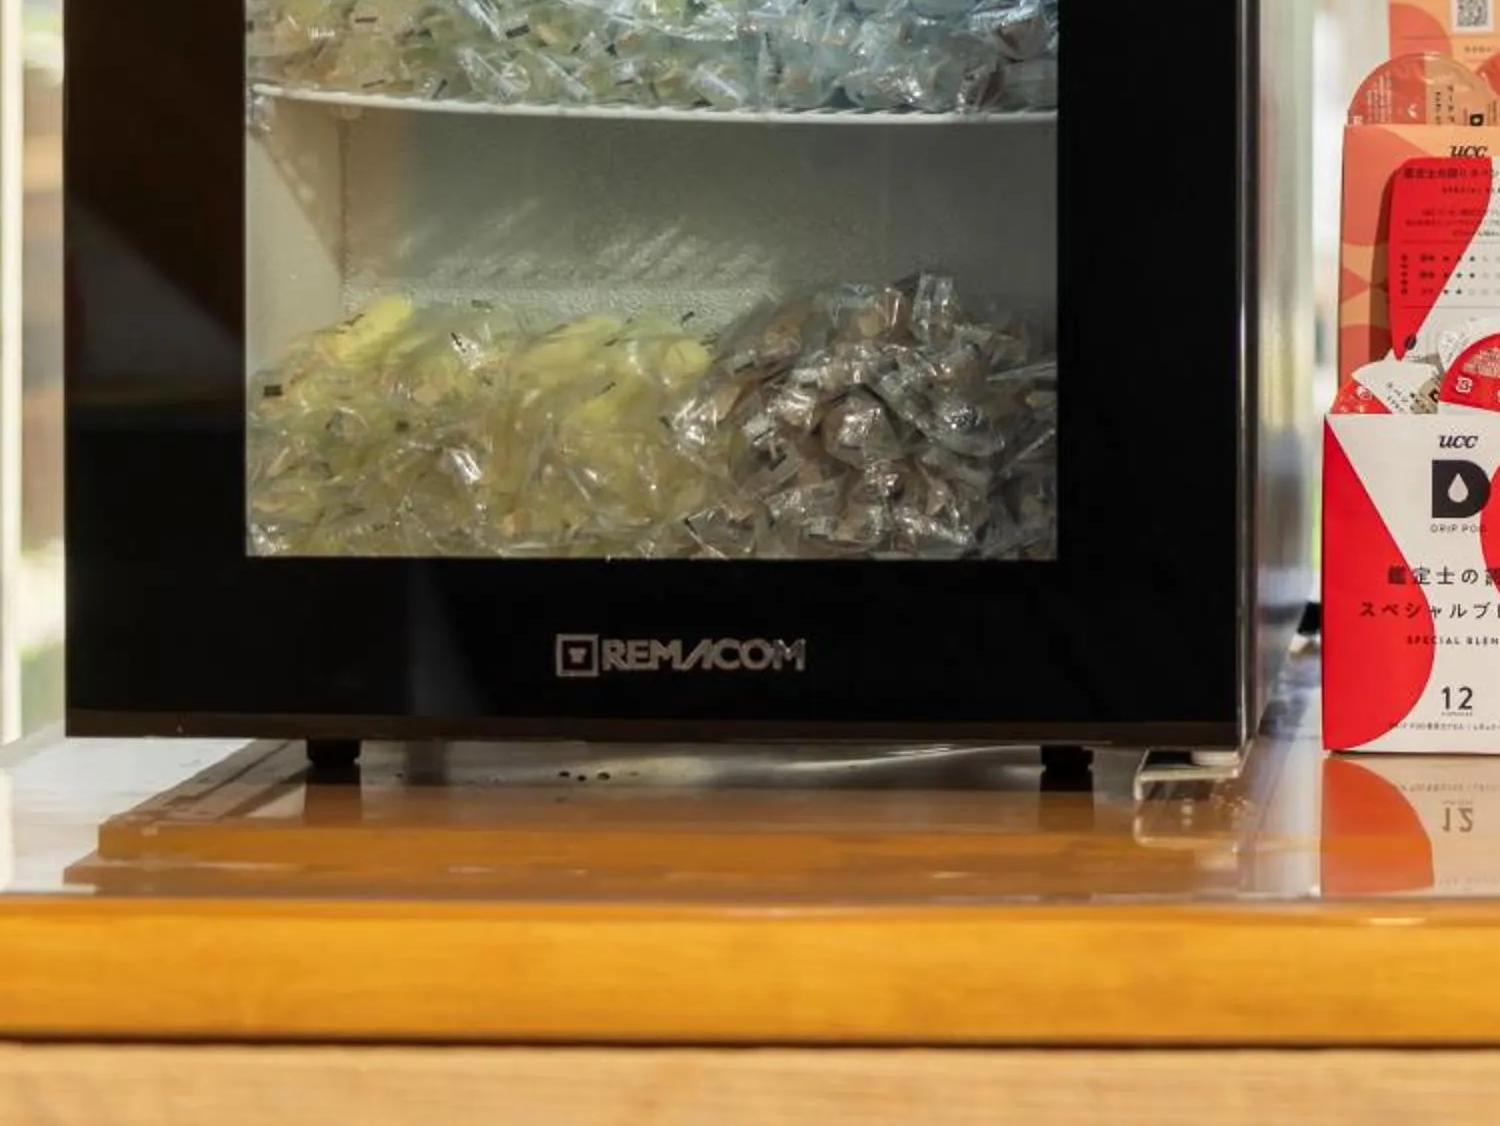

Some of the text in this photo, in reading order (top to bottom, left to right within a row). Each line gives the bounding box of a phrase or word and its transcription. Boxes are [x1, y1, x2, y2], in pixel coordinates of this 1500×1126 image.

[1407, 636, 1460, 645] SPECIAL
[602, 638, 806, 671] REMACOM
[1441, 686, 1473, 710] 12
